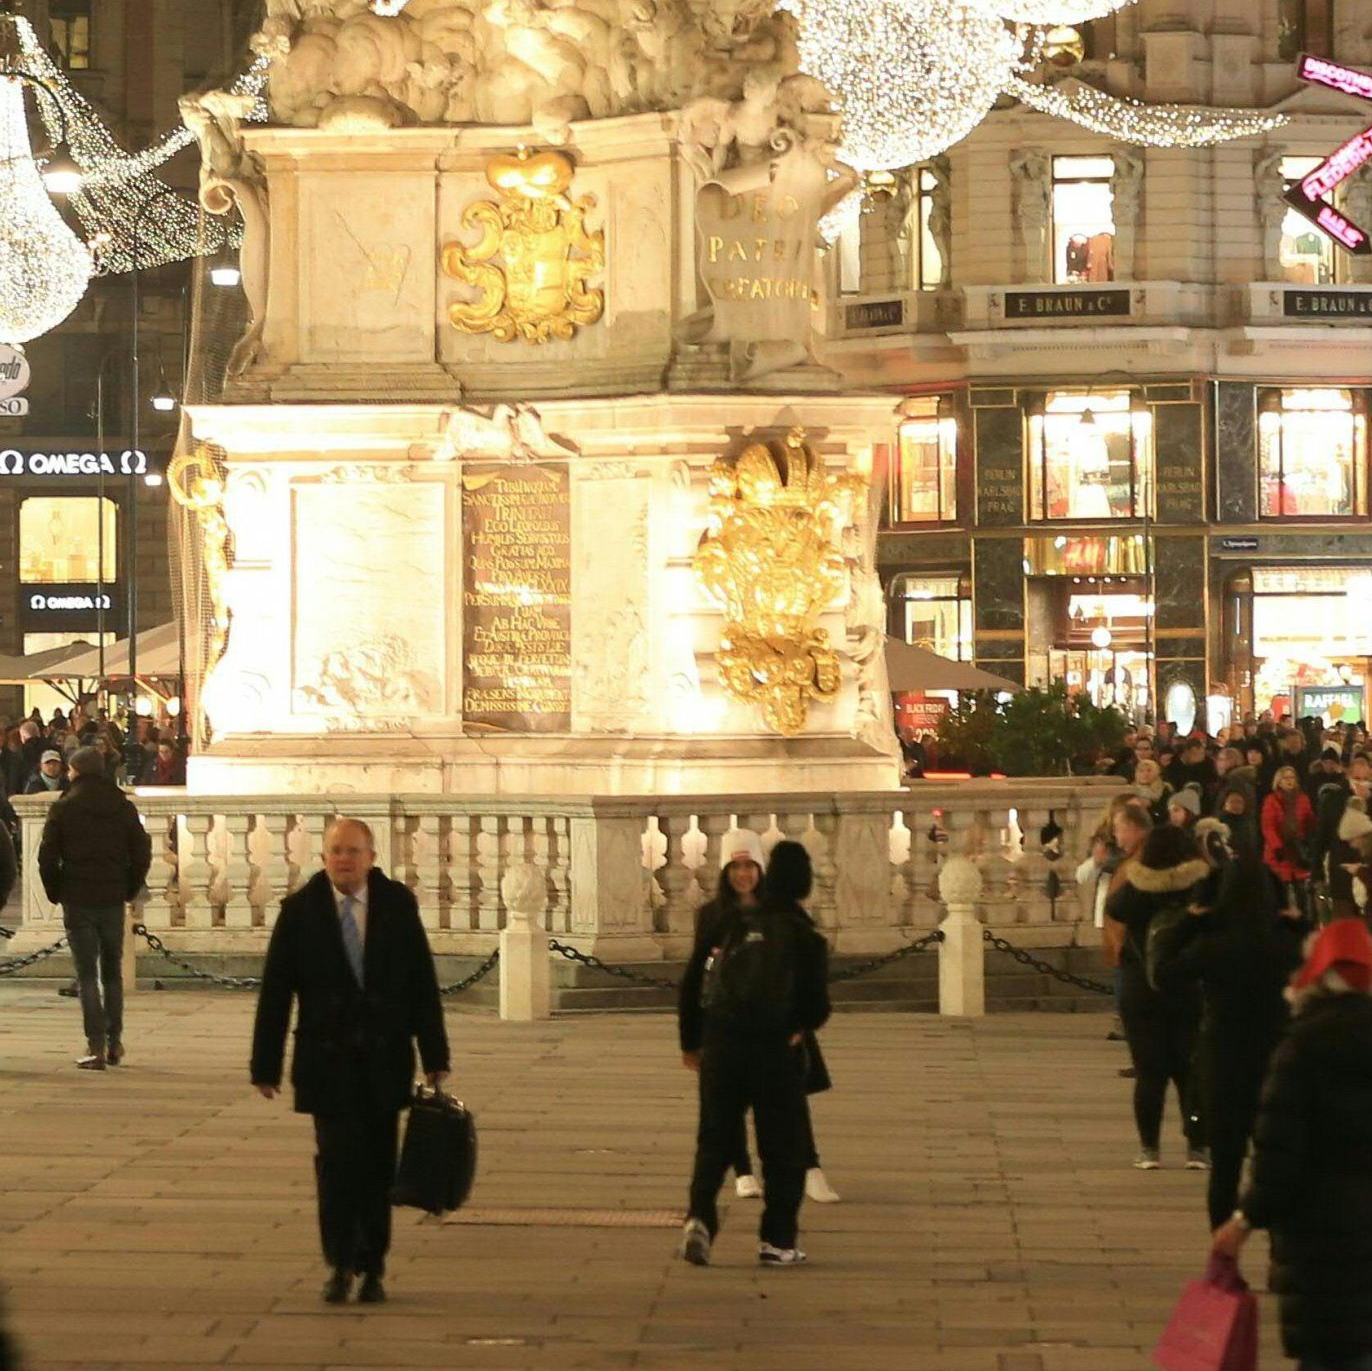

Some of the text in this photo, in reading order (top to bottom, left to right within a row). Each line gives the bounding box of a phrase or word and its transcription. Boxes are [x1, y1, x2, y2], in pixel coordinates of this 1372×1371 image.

[720, 195, 799, 223] DEO
[1036, 298, 1083, 313] BRAUN
[1312, 297, 1354, 312] BRAUN
[29, 453, 115, 475] OMEGA
